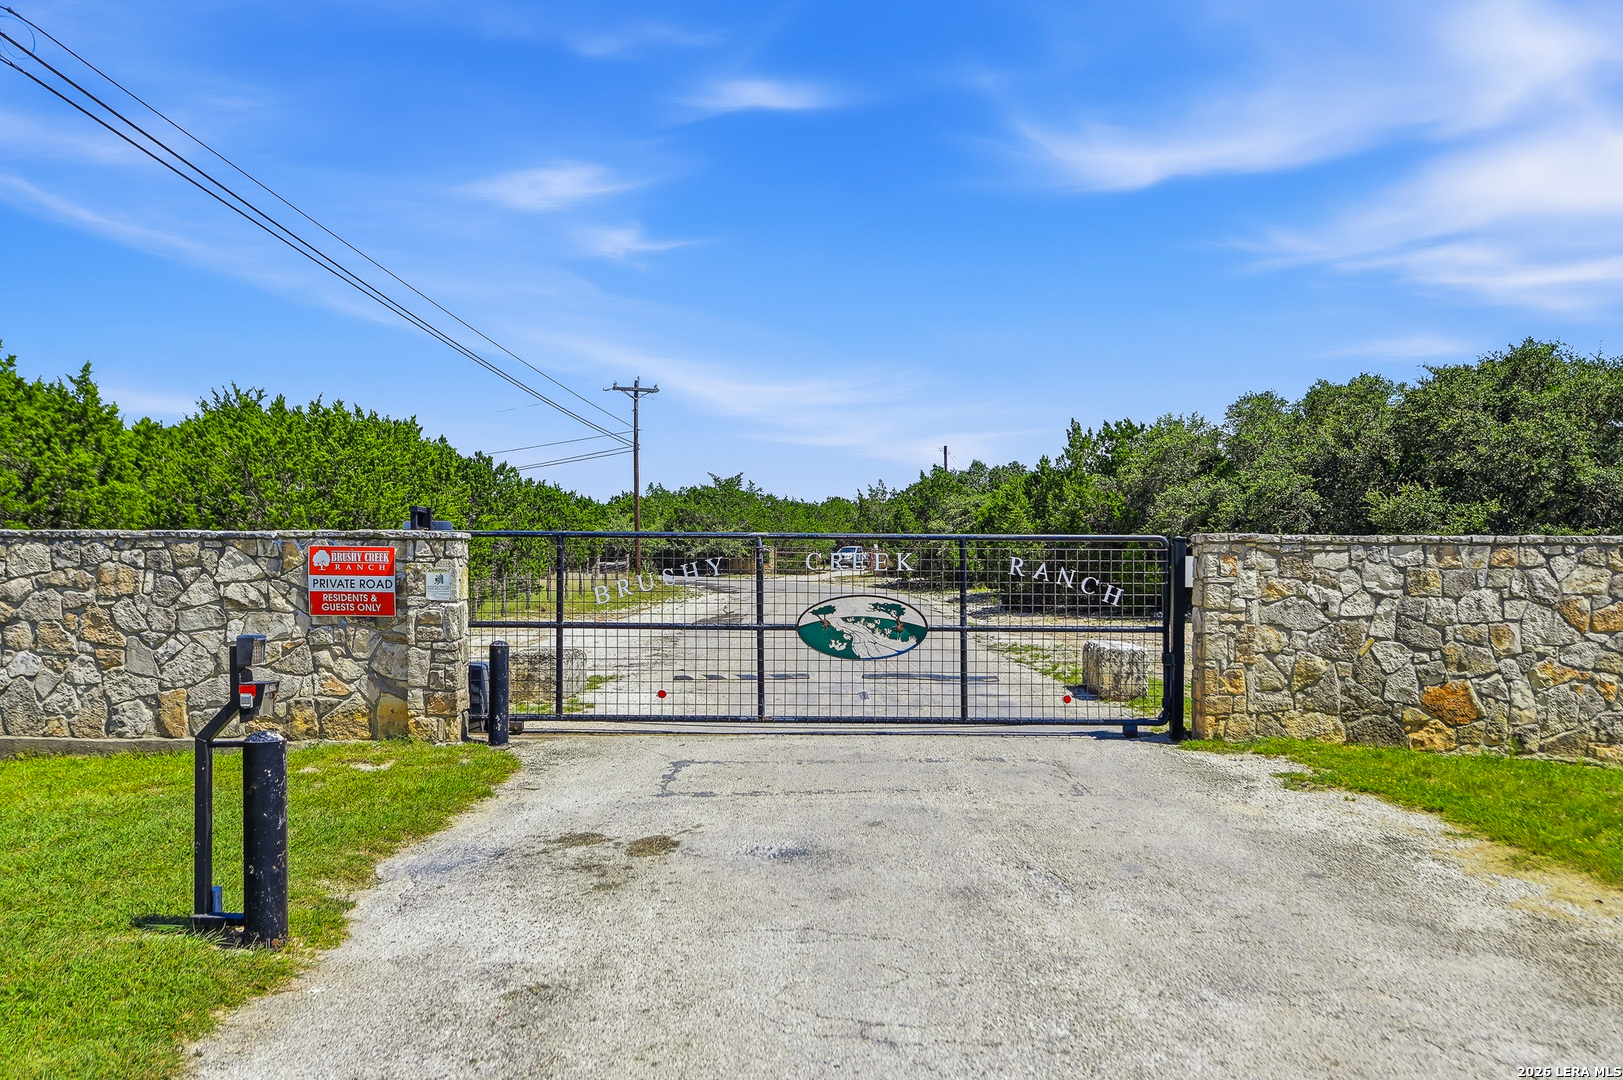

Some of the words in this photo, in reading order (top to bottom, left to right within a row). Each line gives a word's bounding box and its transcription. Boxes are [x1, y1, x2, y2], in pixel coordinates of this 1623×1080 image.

[331, 552, 363, 562] BRUSHY
[364, 552, 389, 562] CREEK
[312, 579, 355, 589] PRIVATE
[359, 578, 393, 589] ROAD
[594, 556, 723, 604] BRUSHY
[806, 552, 914, 571] CREEK
[1008, 556, 1124, 606] RANCH
[322, 593, 368, 602] RESIDENTS
[370, 593, 377, 602] &
[321, 603, 355, 611] GUESTS
[357, 603, 381, 612] ONLY
